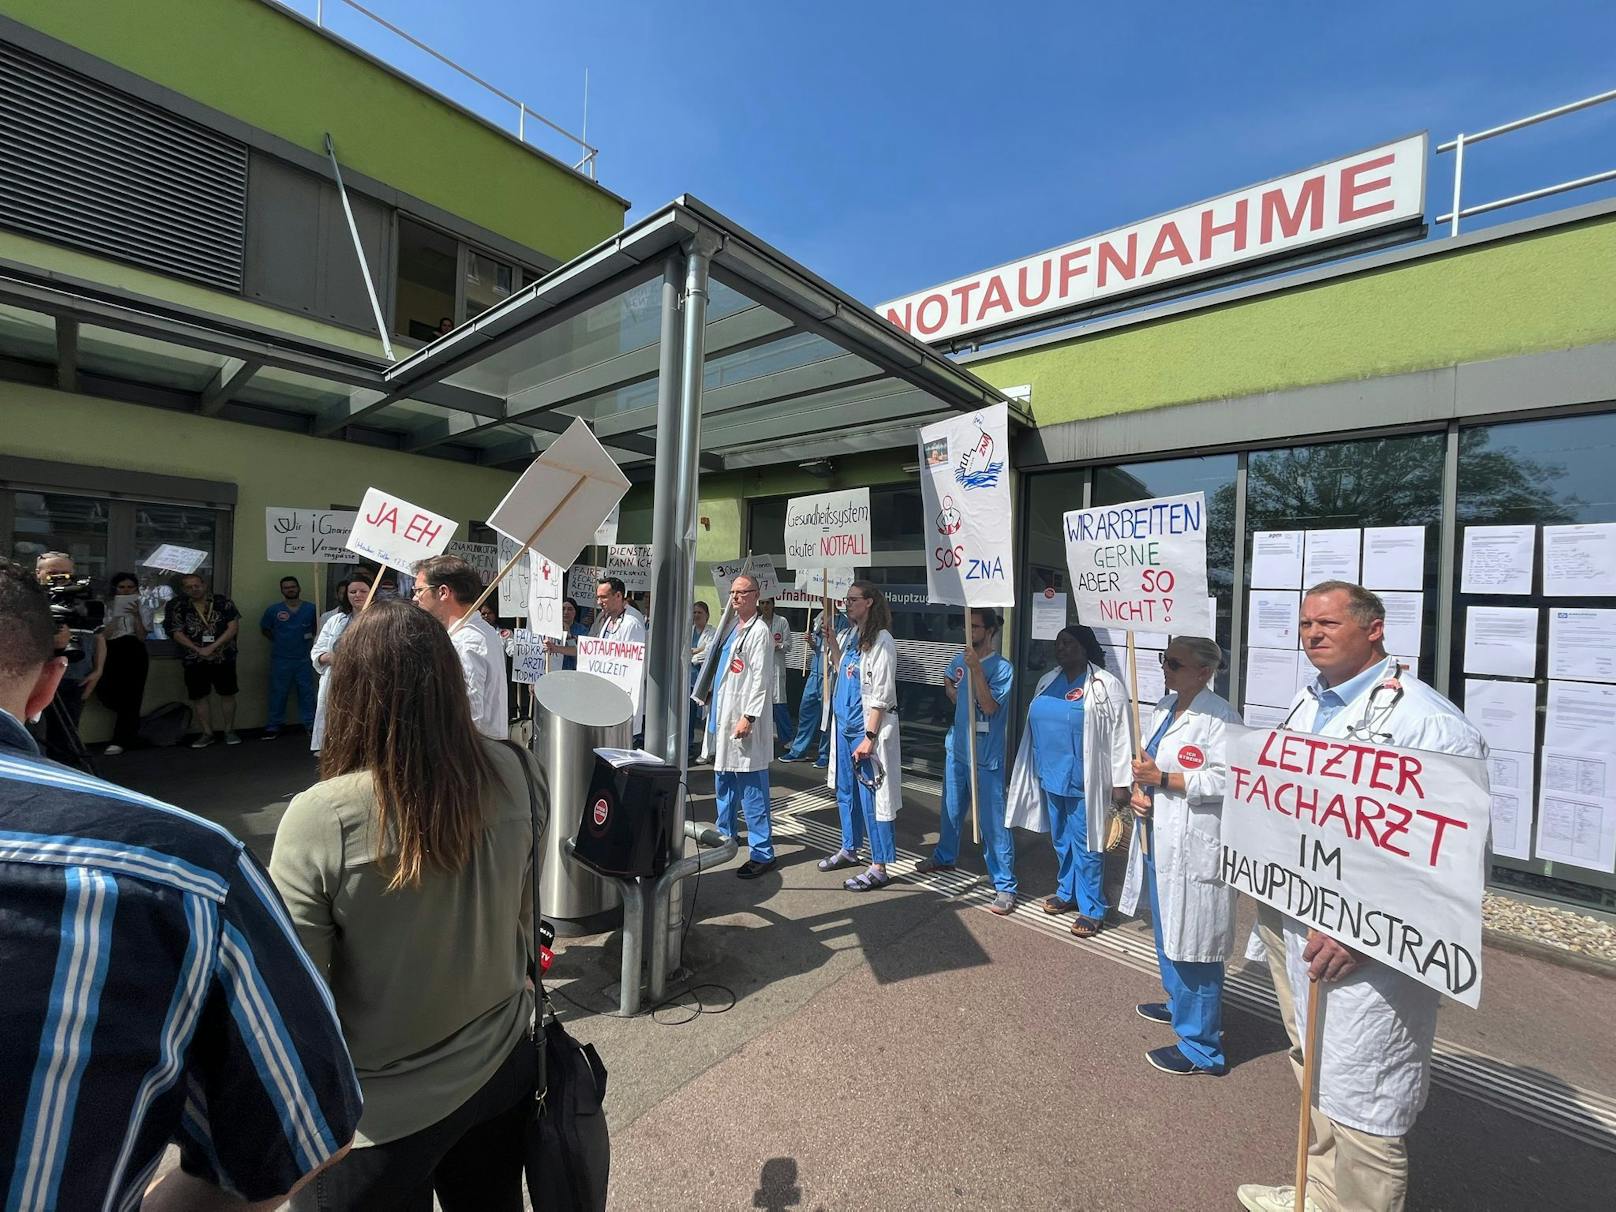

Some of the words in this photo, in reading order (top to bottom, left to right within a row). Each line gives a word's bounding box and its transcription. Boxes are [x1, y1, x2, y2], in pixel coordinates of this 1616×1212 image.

[887, 153, 1395, 335] NOTAUFNAHME
[366, 502, 398, 534] JA
[403, 514, 443, 547] EH
[788, 501, 868, 528] Gesundheitssystem
[1066, 513, 1094, 542] WIR
[1095, 501, 1200, 540] ARBEITEN
[788, 539, 817, 558] akuter
[820, 534, 868, 557] NOTFALL
[1094, 542, 1161, 568] GERNE
[574, 567, 600, 577] FAIRE
[609, 558, 634, 567] KANN
[637, 559, 652, 568] ICH
[935, 545, 964, 572] SOS
[965, 556, 1004, 580] ZNA
[1078, 571, 1120, 592] ABER
[1141, 569, 1175, 593] SO
[579, 641, 645, 661] NOTAUFNAHME
[589, 660, 628, 677] VOLLZEIT
[1258, 731, 1425, 799] LETZTER
[1230, 765, 1468, 866] FACHARZT
[1300, 834, 1342, 880] IM
[1222, 845, 1477, 994] HAUPTDIENSTRAD
